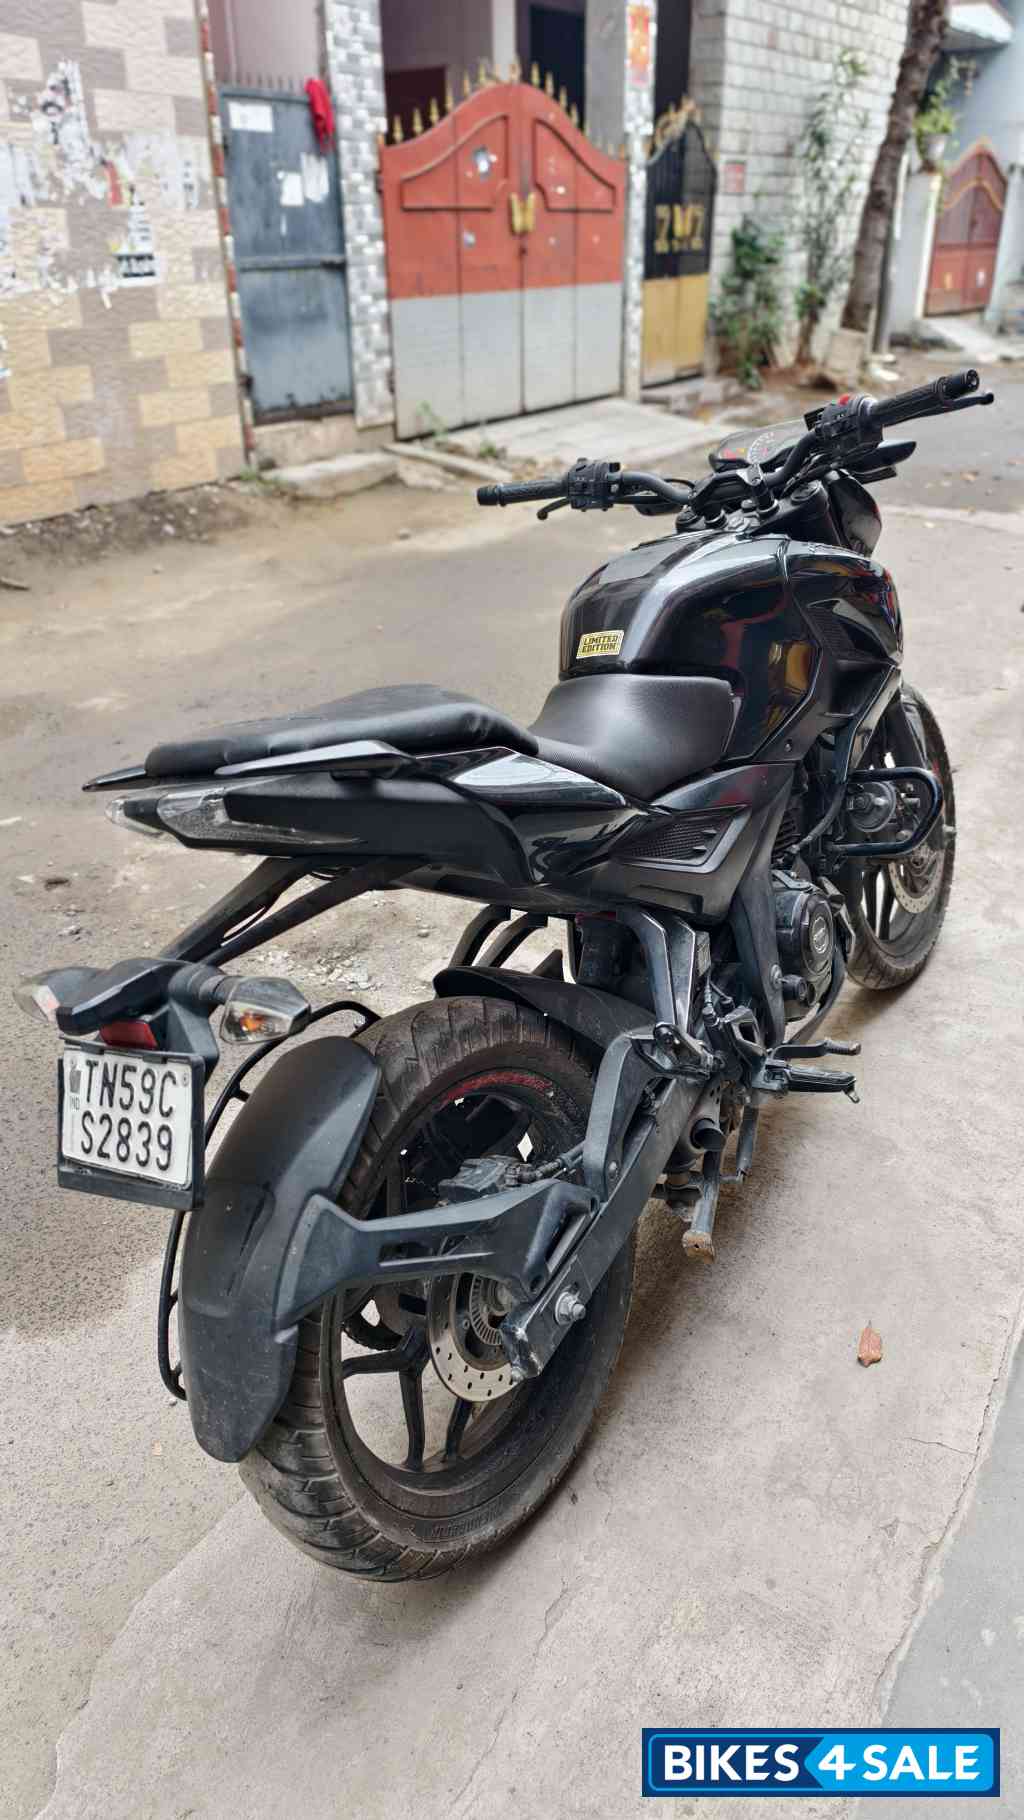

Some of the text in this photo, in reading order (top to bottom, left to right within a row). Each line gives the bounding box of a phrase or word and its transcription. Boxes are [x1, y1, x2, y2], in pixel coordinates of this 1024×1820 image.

[582, 643, 617, 653] EDITION
[584, 635, 619, 645] LIMITED
[83, 1059, 177, 1119] TN59C
[80, 1110, 174, 1172] S2839
